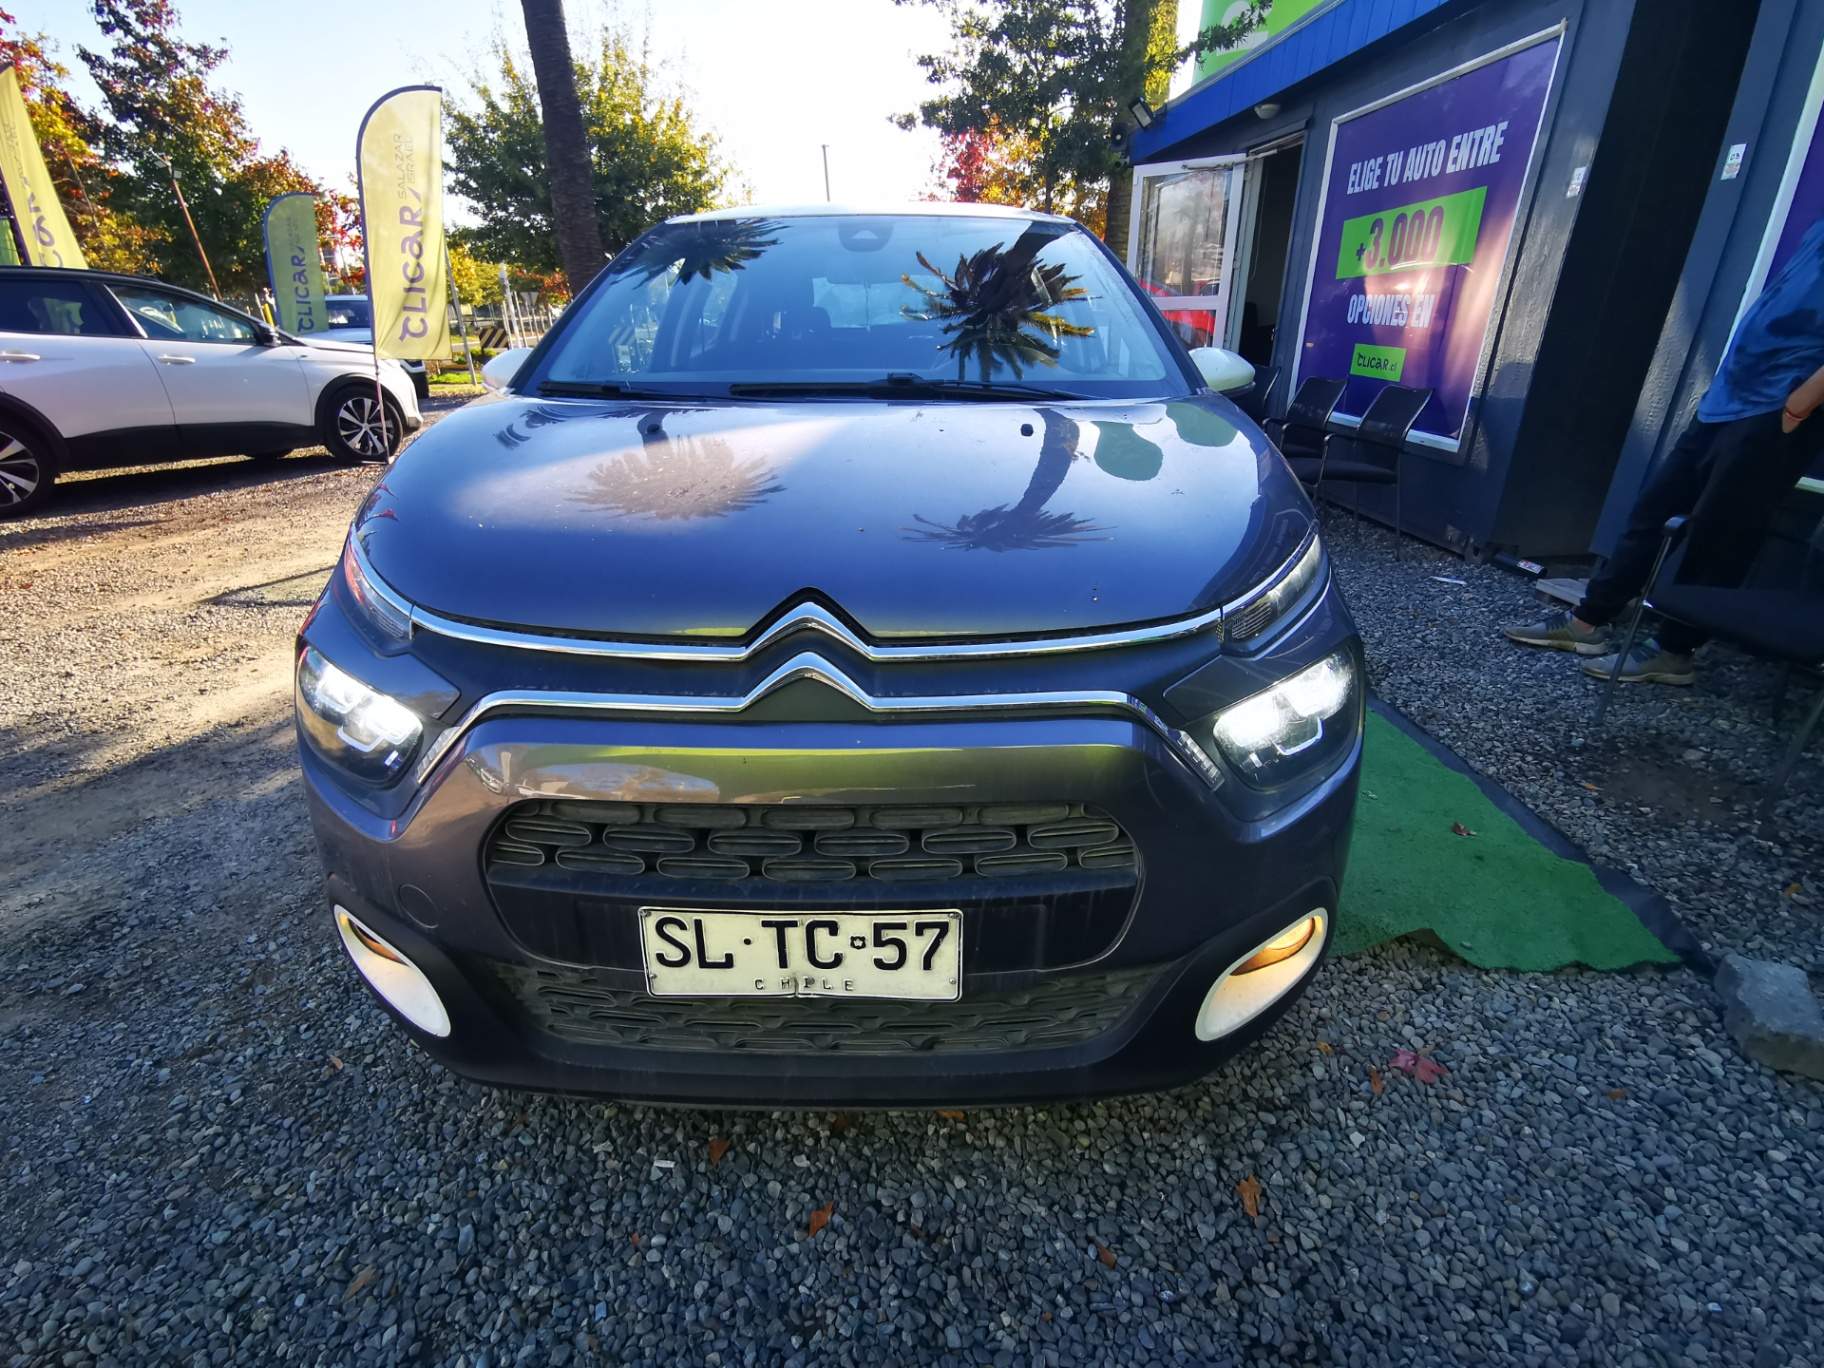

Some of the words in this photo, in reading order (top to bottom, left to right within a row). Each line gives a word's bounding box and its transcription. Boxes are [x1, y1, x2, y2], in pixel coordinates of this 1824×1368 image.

[1346, 156, 1383, 195] ELIGE
[1383, 150, 1404, 188] TU
[1402, 139, 1446, 183] AUTO
[1445, 120, 1509, 174] ENTRE
[1355, 205, 1444, 270] +3.000
[1346, 293, 1411, 327] OPCIONES
[1411, 294, 1435, 329] EN
[754, 978, 854, 992] CHILE
